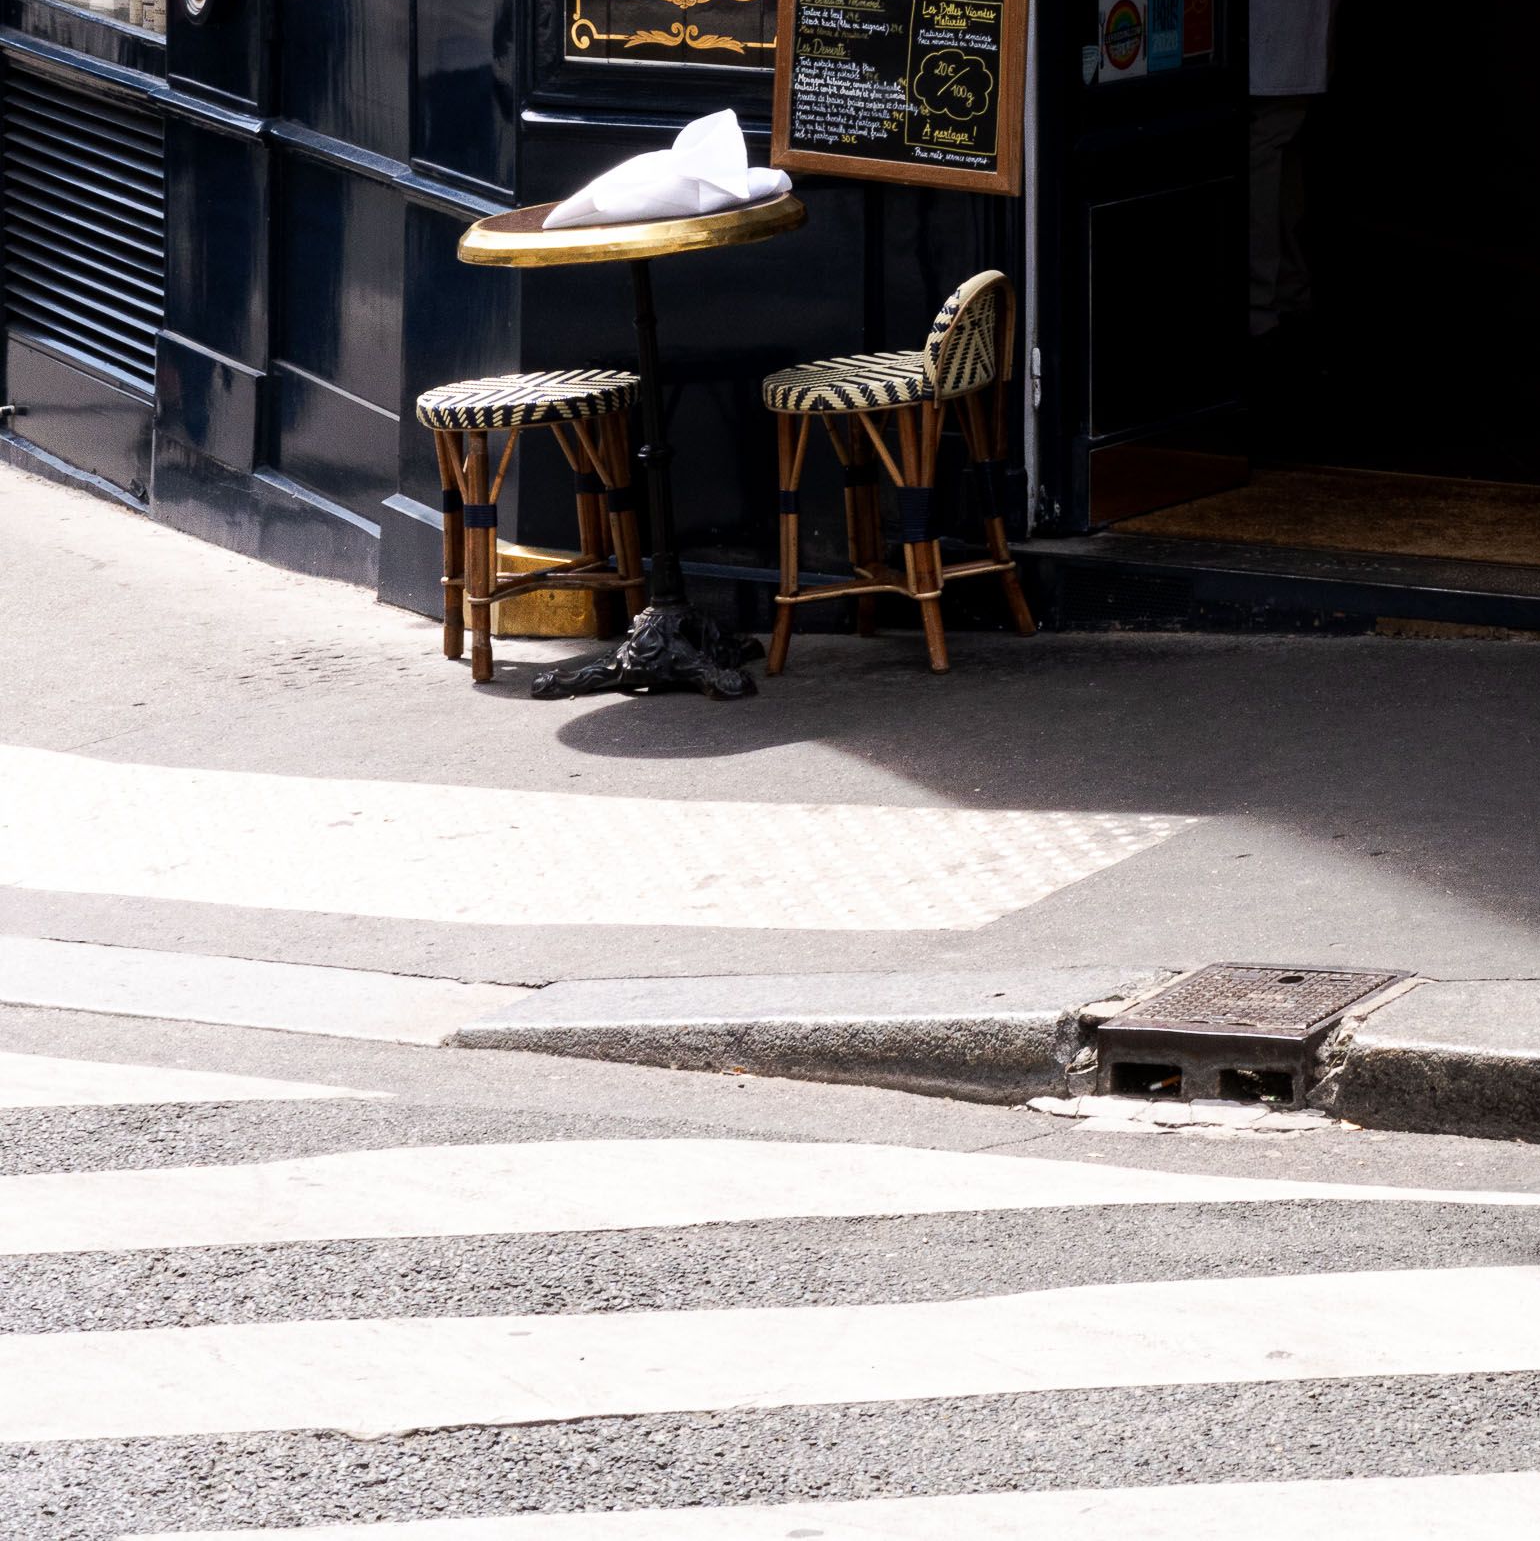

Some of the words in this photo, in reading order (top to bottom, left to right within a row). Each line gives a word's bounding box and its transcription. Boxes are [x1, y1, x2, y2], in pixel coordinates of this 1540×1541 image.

[922, 0, 937, 15] Les
[965, 5, 996, 19] Viandes
[934, 61, 956, 76] 20€
